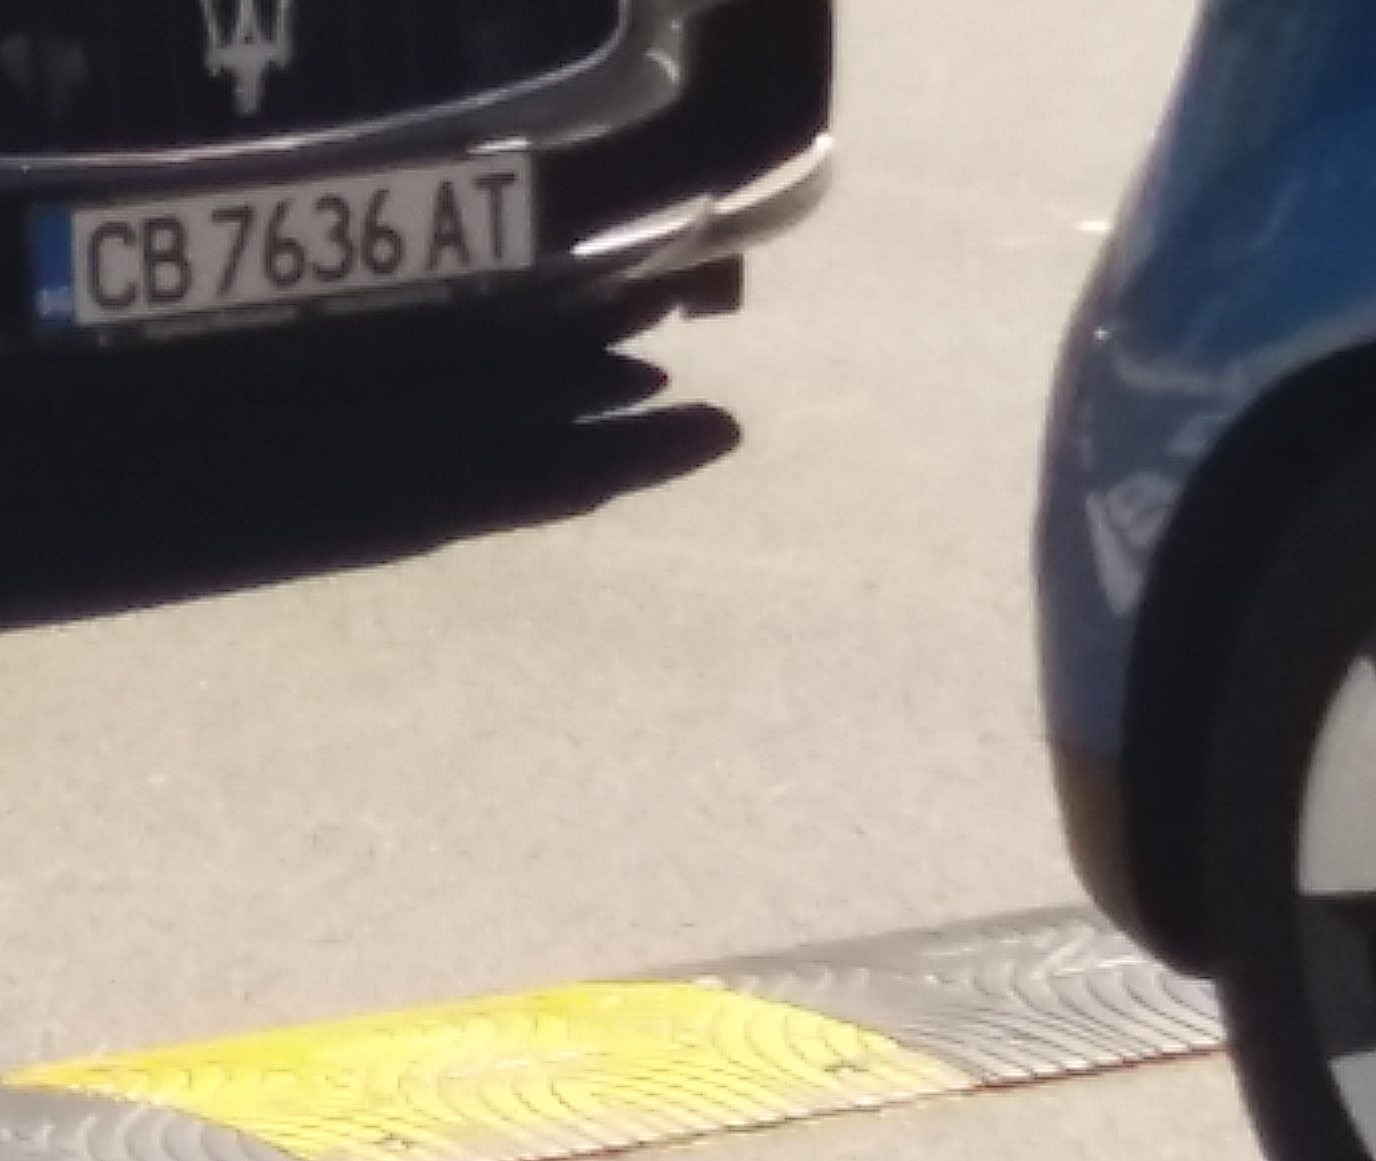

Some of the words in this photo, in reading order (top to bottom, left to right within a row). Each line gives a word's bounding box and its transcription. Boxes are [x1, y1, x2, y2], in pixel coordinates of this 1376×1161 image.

[86, 215, 192, 309] CB
[211, 187, 404, 299] 7636
[428, 172, 517, 271] AT
